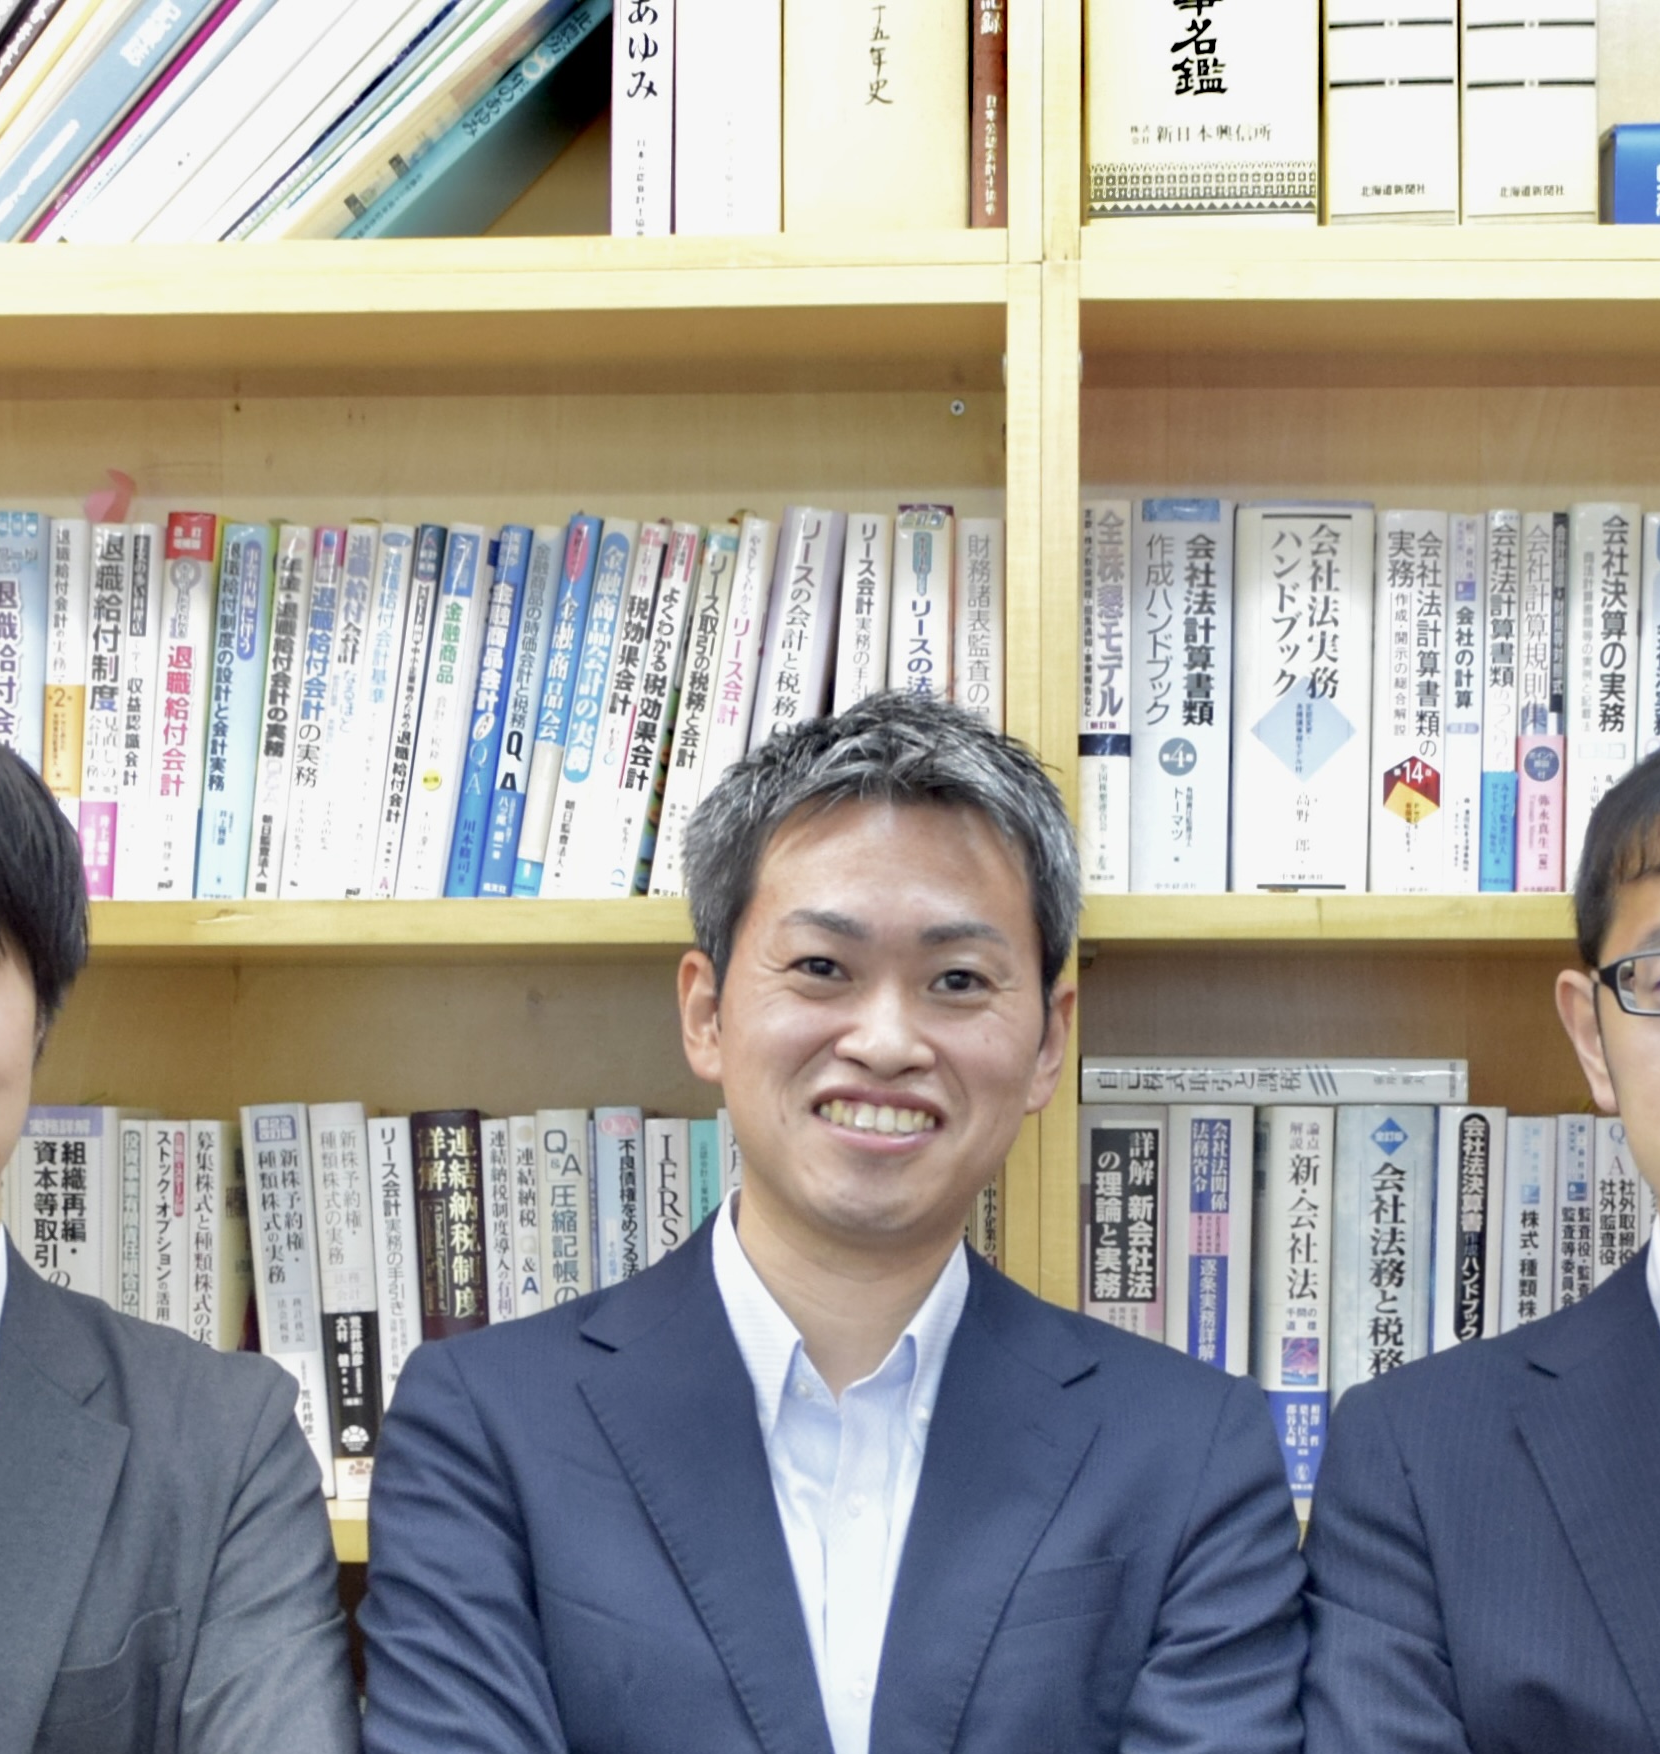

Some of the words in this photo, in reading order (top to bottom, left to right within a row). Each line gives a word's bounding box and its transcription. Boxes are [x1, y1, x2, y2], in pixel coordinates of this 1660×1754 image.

[1361, 183, 1425, 198] 北海道新聞社
[1500, 183, 1565, 198] 北海道新聞社
[89, 533, 124, 713] 退職給付制度
[1096, 509, 1125, 718] 全株懇モデル
[1145, 533, 1175, 727] 作成ハンドブック
[1182, 532, 1216, 727] 会社法計算書類
[1271, 530, 1303, 699] ハンドブック
[1307, 523, 1342, 700] 会社法実務
[1387, 529, 1416, 589] 実務
[1523, 523, 1551, 730] 会社計算規則集
[1598, 514, 1630, 733] 会社決算の実務
[295, 587, 335, 788] 退職給付会計の実務
[435, 603, 464, 685] 金融商品
[566, 544, 626, 772] 金融商品会計の実務
[608, 596, 650, 717] 税効果会計
[625, 587, 681, 792] よくわかる税効果会計
[676, 550, 721, 770] リース取引の税務と会計
[1393, 593, 1408, 736] 作成・開示の総合解説
[1415, 529, 1443, 758] 会社法計算書類の
[1454, 605, 1475, 710] 会社の計算
[122, 677, 144, 787] 収益認識会計
[159, 645, 193, 798] 退職給付会計
[1170, 786, 1183, 842] トーマツ
[1537, 793, 1551, 850] 弥永真生
[33, 1139, 71, 1287] 資本等取引の
[60, 1139, 87, 1256] 組織再編・
[257, 1149, 287, 1285] 種類株式の実務
[280, 1149, 305, 1264] 新株予約権・
[320, 1130, 345, 1266] 種類株式の実務
[339, 1130, 362, 1237] 新株予約権・
[380, 1127, 403, 1316] リース会計実務の手引き
[447, 1126, 479, 1318] 連結納税制度
[543, 1128, 582, 1177] Q&A
[659, 1134, 682, 1247] IFRS
[1128, 1130, 1155, 1186] 詳解
[1191, 1121, 1210, 1193] 法務省令
[1211, 1121, 1229, 1213] 会社法関係
[1598, 1179, 1617, 1266] 社外監査役
[155, 1130, 172, 1322] ストック・オプションの活用
[551, 1185, 581, 1303] 圧縮記帳の
[1094, 1151, 1122, 1300] の理論と実務
[1127, 1195, 1154, 1300] 新会社法
[1286, 1153, 1320, 1301] 新・会社法
[1367, 1161, 1408, 1376] 会社法務と税務
[1461, 1118, 1486, 1341] 会社法決算書作成ハンドブック
